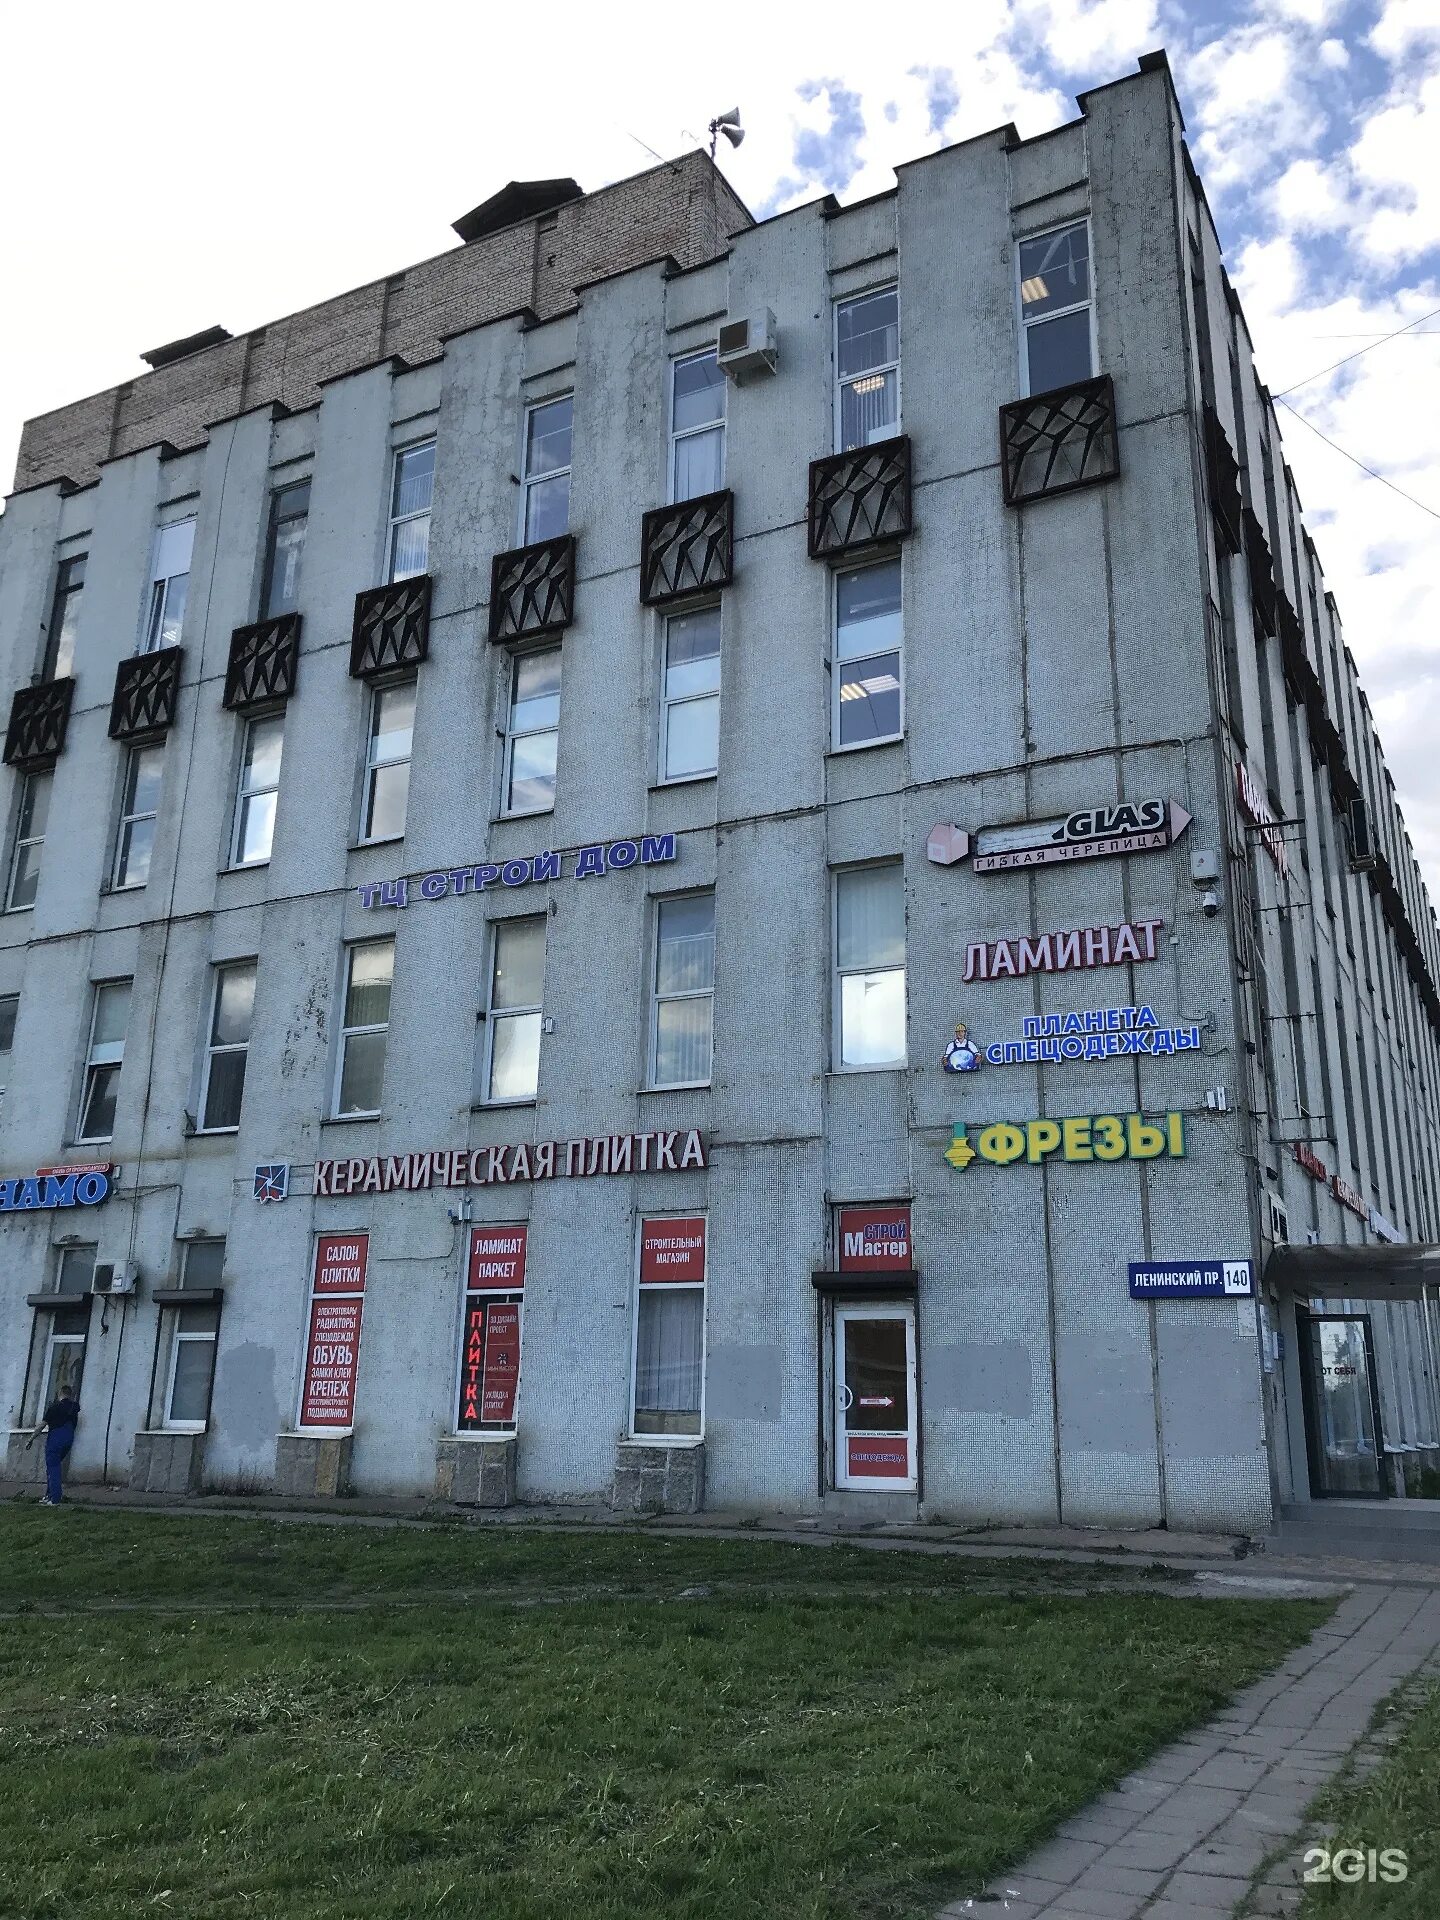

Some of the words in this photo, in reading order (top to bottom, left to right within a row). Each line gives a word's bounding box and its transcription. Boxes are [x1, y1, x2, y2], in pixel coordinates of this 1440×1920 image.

[1065, 799, 1164, 841] GLAS
[1060, 834, 1162, 858] ЧЕРЕПИЦА
[358, 880, 407, 908] ТЦ
[420, 851, 562, 899] СТРОЙ
[574, 833, 677, 879] ДОМ
[962, 919, 1163, 983] ЛАМИНАТ
[1022, 1005, 1158, 1038] ПЛАНЕТА
[986, 1026, 1200, 1065] СПЕЦОДЕЖДЫ
[978, 1111, 1187, 1165] ФРЕЗЫ
[312, 1141, 558, 1195] КЕРАМИЧЕСКАЯ
[565, 1129, 706, 1177] ПЛИТКА
[863, 1219, 907, 1240] СТРОЙ
[474, 1238, 523, 1255] ЛАМИНАТ
[645, 1235, 702, 1250] СТРОИТЕЛЬНЫЙ
[844, 1232, 908, 1258] Мастер
[326, 1245, 359, 1262] САЛОН
[655, 1251, 690, 1264] МАГАЗИН
[320, 1266, 361, 1284] ПЛИТКИ
[478, 1261, 517, 1278] ПАРКЕТ
[1134, 1269, 1202, 1287] ЛЕНИНСКИЙ
[1204, 1272, 1223, 1286] ПР.
[1226, 1269, 1248, 1287] 140
[316, 1318, 356, 1329] РАДИАТОРЫ
[312, 1345, 353, 1365] ОБУВЬ
[464, 1311, 483, 1419] ПЛИТКА
[311, 1367, 333, 1378] ЗАМКИ
[1334, 1367, 1356, 1375] СЕБЯ
[310, 1380, 350, 1397] КРЕПЕЖ
